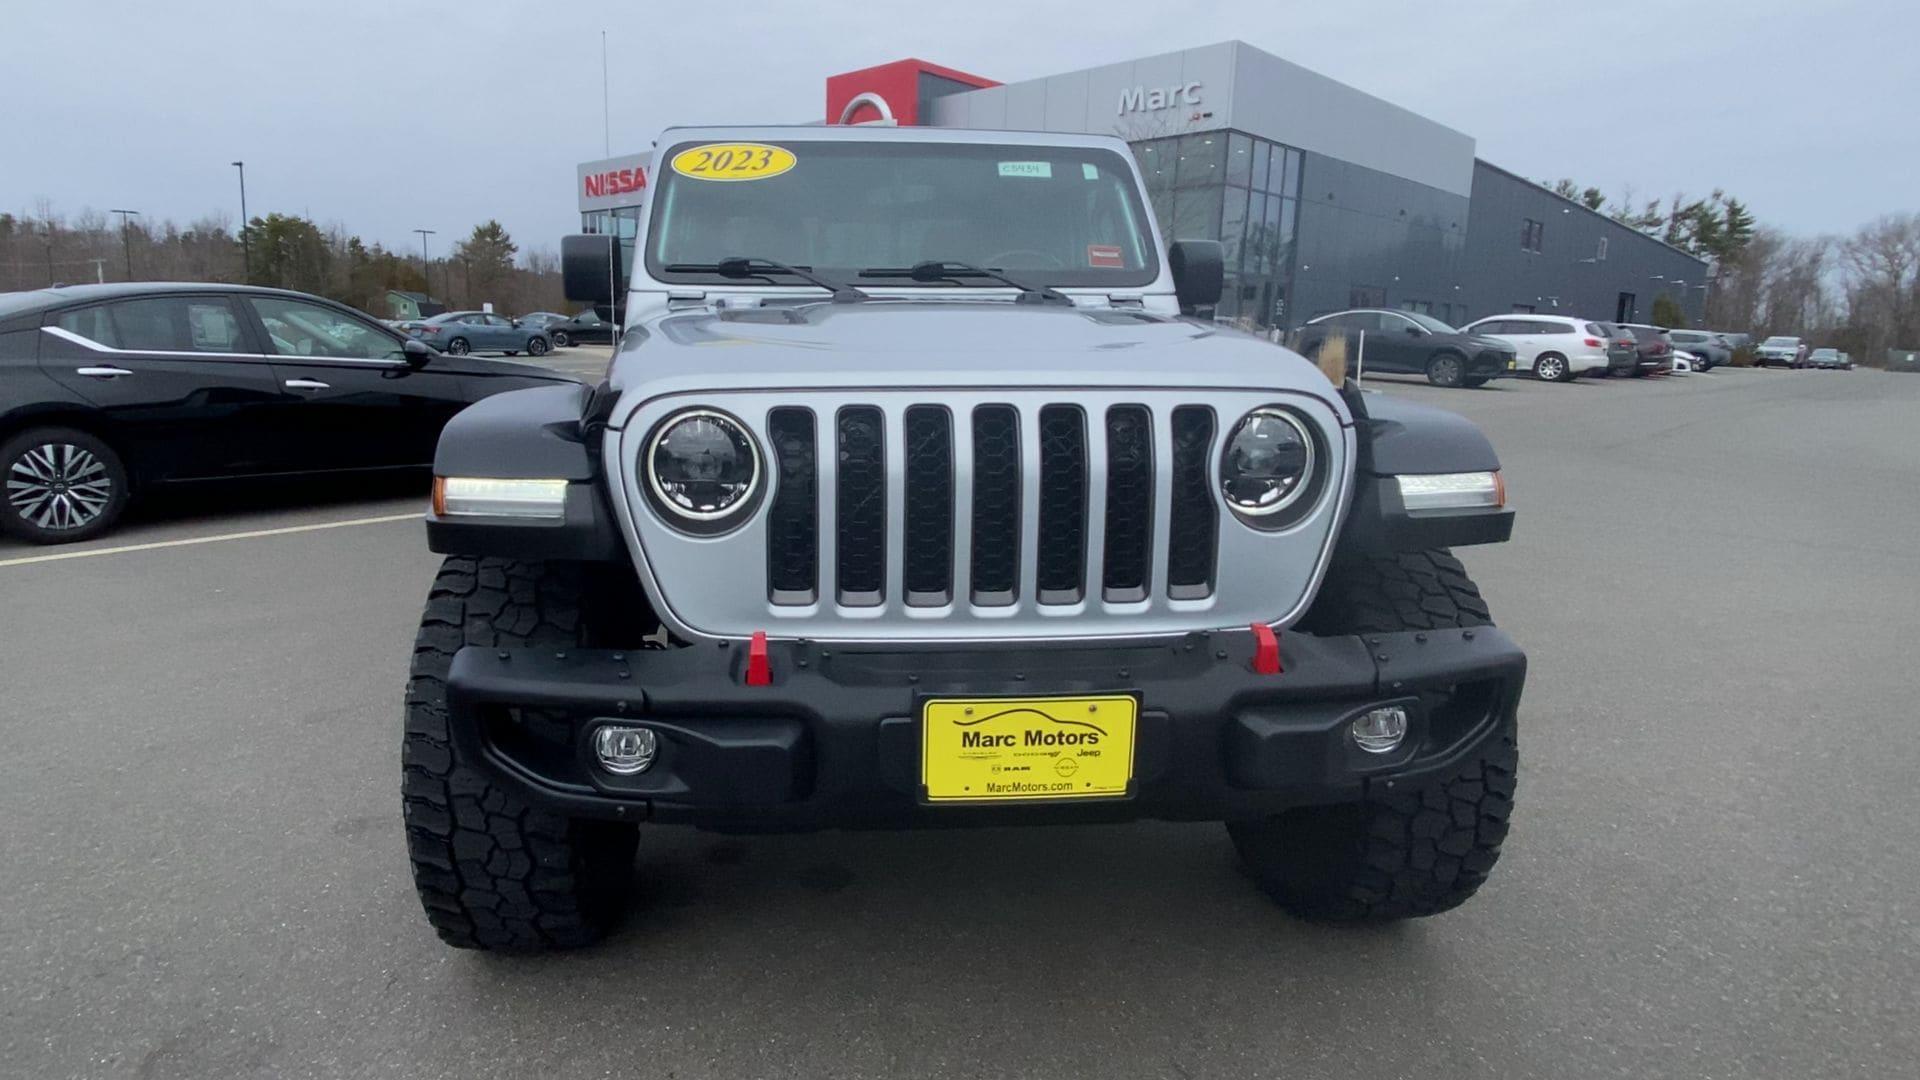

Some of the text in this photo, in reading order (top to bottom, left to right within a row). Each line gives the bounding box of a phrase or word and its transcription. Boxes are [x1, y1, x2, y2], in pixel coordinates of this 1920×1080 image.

[1117, 81, 1203, 116] Marc
[690, 150, 774, 172] 2023
[585, 167, 650, 197] NISSA
[962, 730, 1099, 748] Marc Motors
[1077, 749, 1101, 757] Jeep
[987, 782, 1073, 793] MarcMotors.com
